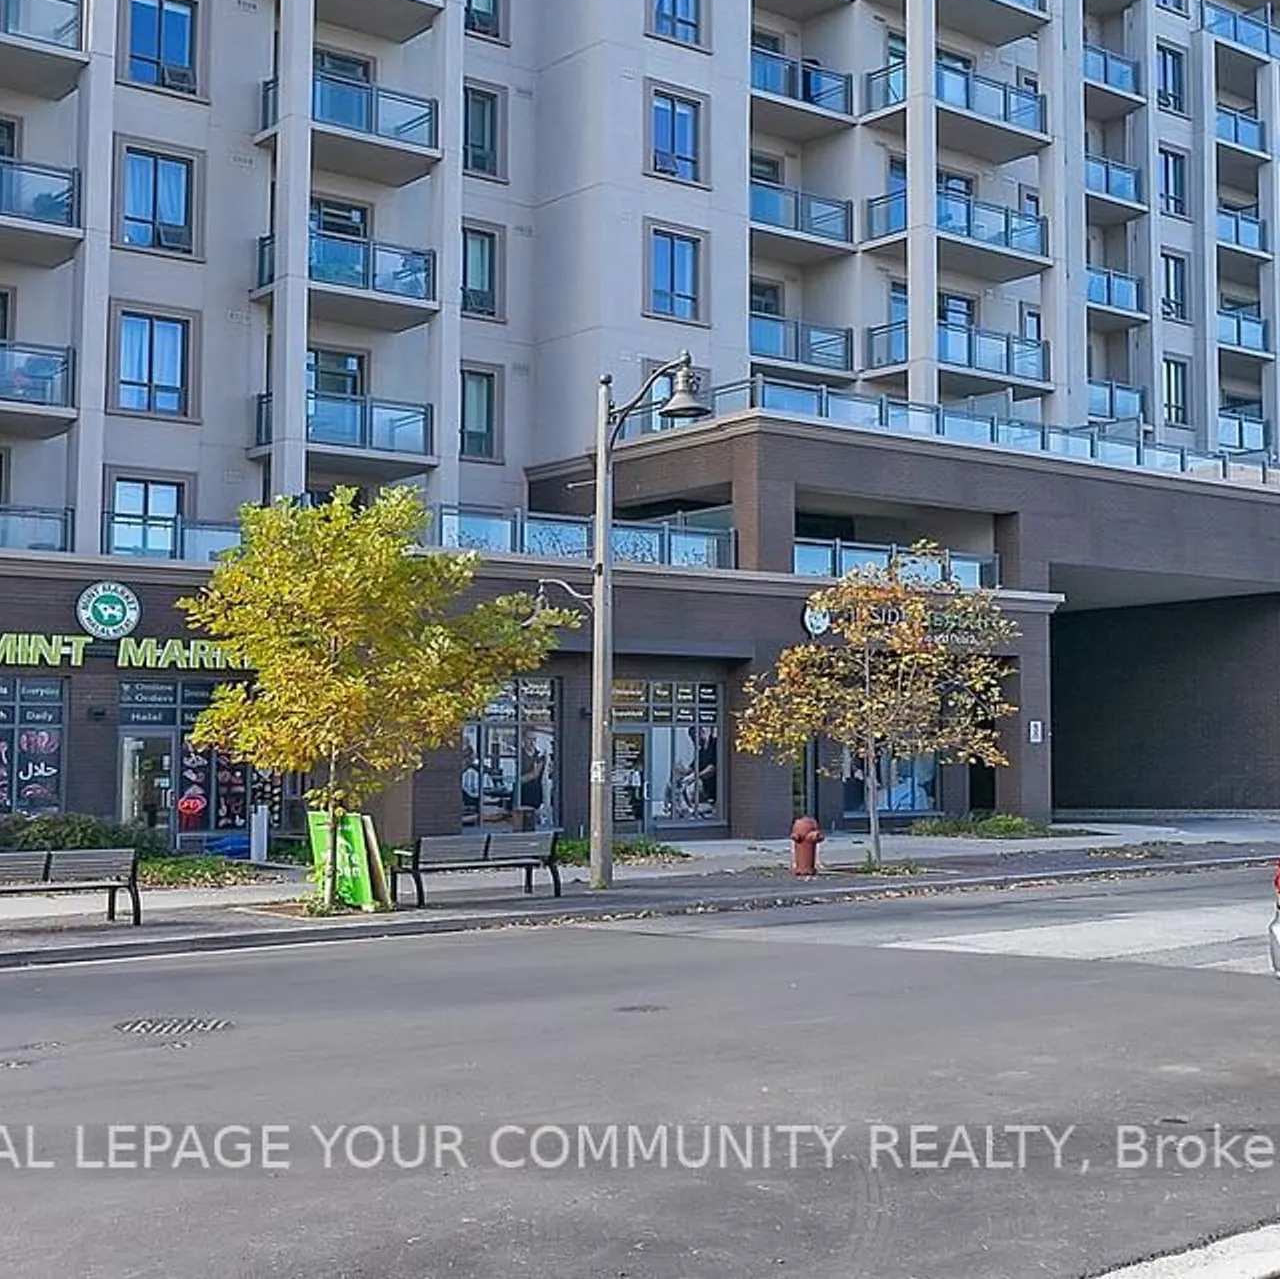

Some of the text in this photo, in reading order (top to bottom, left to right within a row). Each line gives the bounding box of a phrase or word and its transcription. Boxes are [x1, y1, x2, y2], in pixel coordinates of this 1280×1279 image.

[116, 636, 260, 670] MARK
[25, 710, 54, 722] Daily
[131, 712, 162, 722] Halal
[19, 762, 59, 781] حلال
